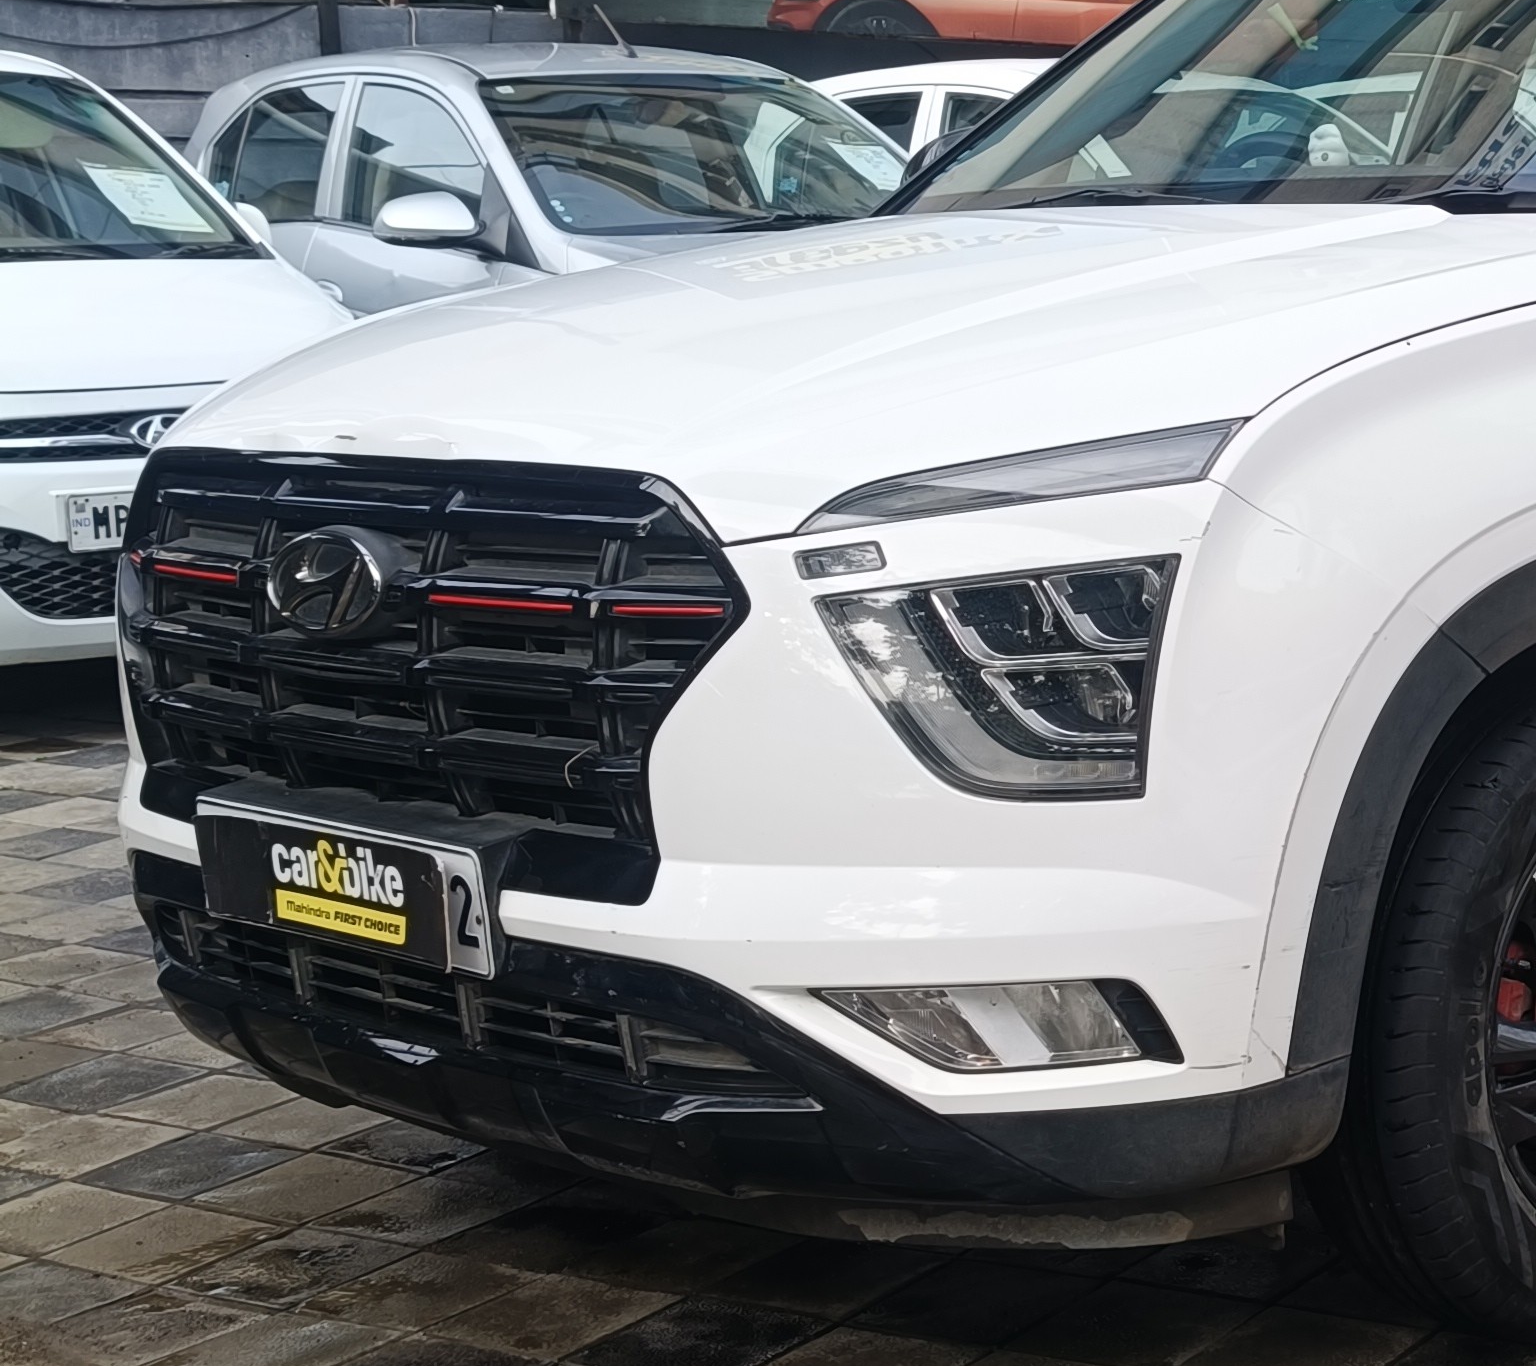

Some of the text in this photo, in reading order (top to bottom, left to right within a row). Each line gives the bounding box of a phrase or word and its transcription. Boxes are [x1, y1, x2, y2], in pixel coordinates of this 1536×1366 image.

[72, 504, 130, 539] IND MP
[271, 840, 405, 907] car&bike
[286, 900, 401, 935] Mahindra FIRST CHOICE
[450, 875, 480, 949] 2
